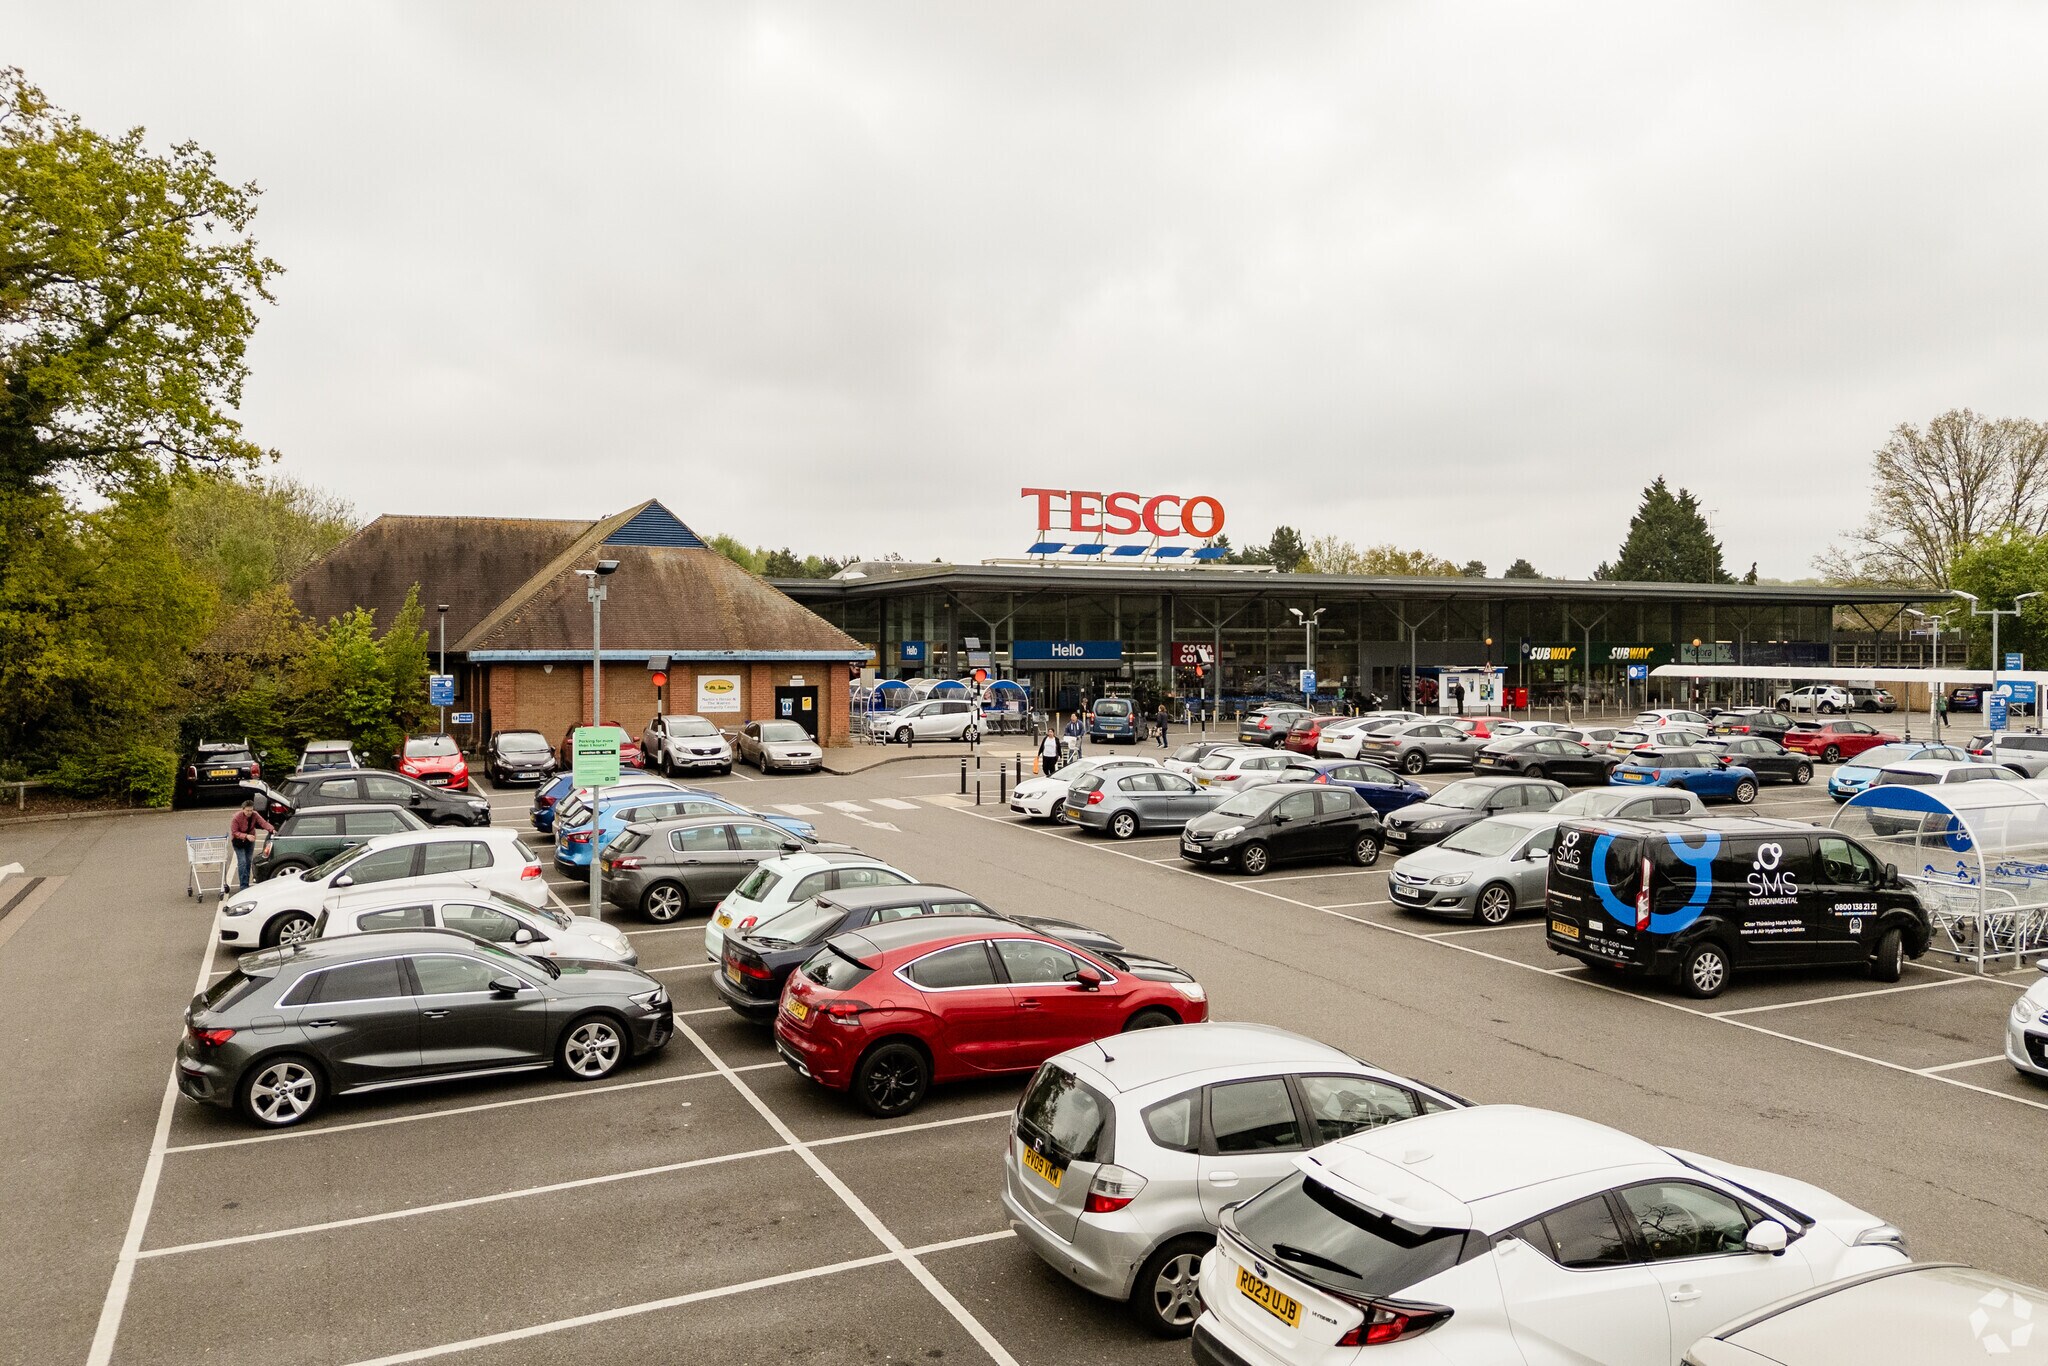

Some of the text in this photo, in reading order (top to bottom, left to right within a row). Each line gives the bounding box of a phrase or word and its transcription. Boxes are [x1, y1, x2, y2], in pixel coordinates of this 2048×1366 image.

[1021, 488, 1225, 537] TESCO
[906, 645, 918, 655] Hello
[1052, 643, 1084, 656] Hello
[1529, 646, 1577, 660] SUBWAY
[1608, 646, 1654, 660] SUBWAY
[1180, 654, 1215, 663] COE
[1556, 845, 1581, 865] SMS
[1746, 872, 1799, 896] SMS
[1748, 897, 1799, 906] ENVIRONMENTAL
[1834, 902, 1877, 911] 0800 138 21 21
[1025, 1148, 1044, 1173] RV09
[1240, 1270, 1298, 1321] RO23 UJB
